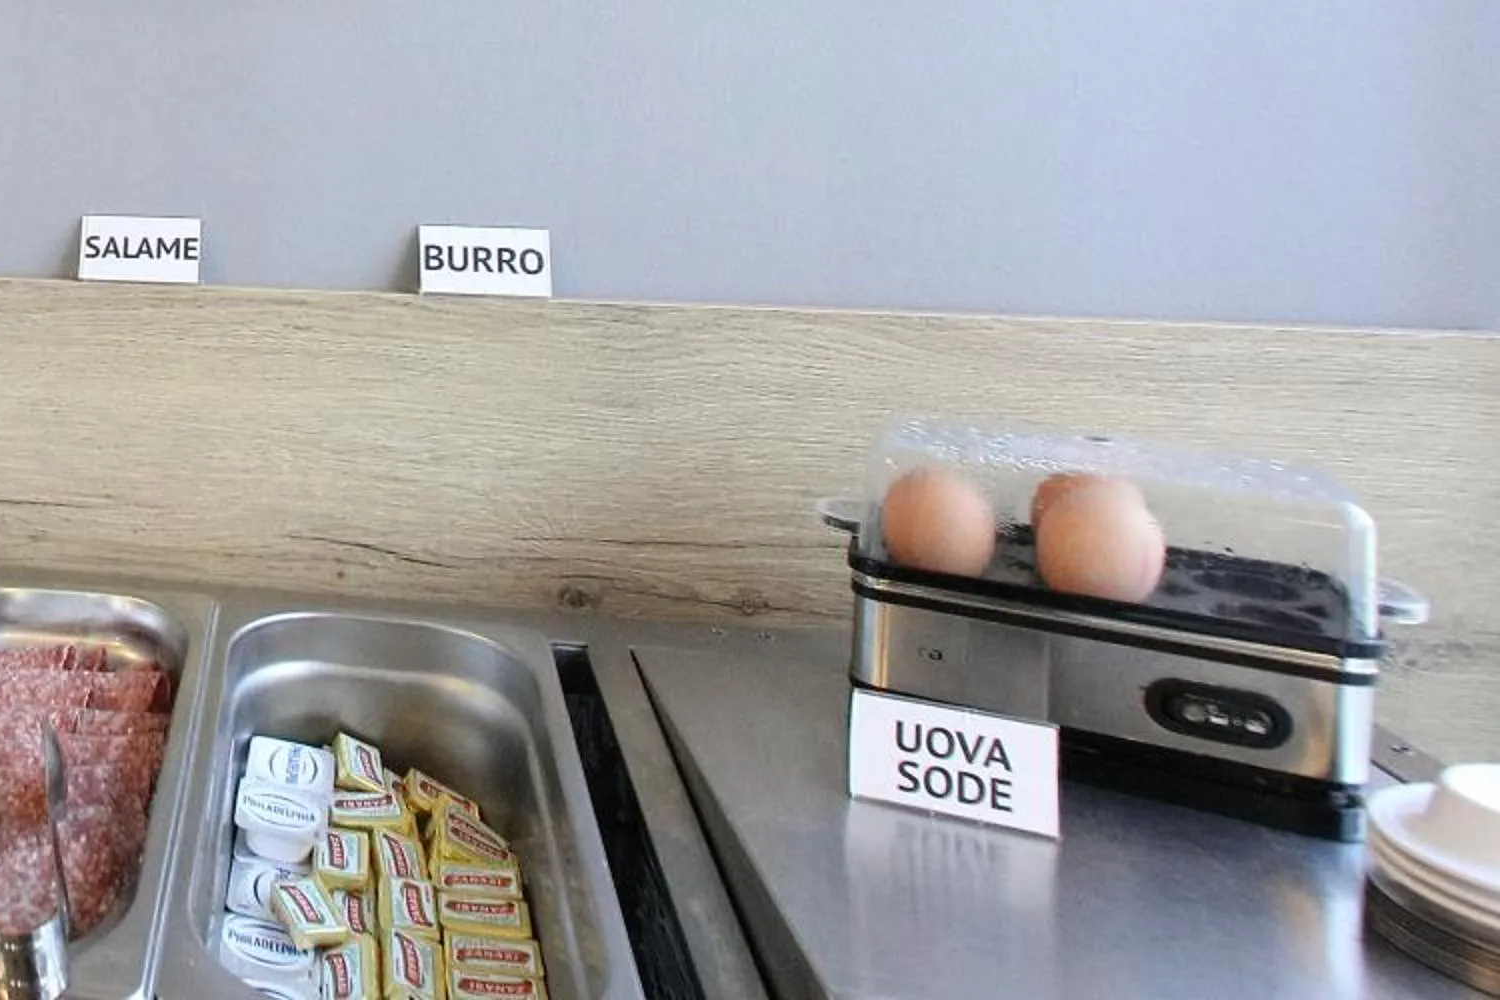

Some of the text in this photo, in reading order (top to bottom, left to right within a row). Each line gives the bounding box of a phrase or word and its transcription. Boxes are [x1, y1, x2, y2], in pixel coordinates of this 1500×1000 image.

[85, 236, 199, 260] SALAME
[424, 244, 545, 275] BURRO
[895, 720, 1012, 772] UOVA
[897, 761, 1013, 812] SODE
